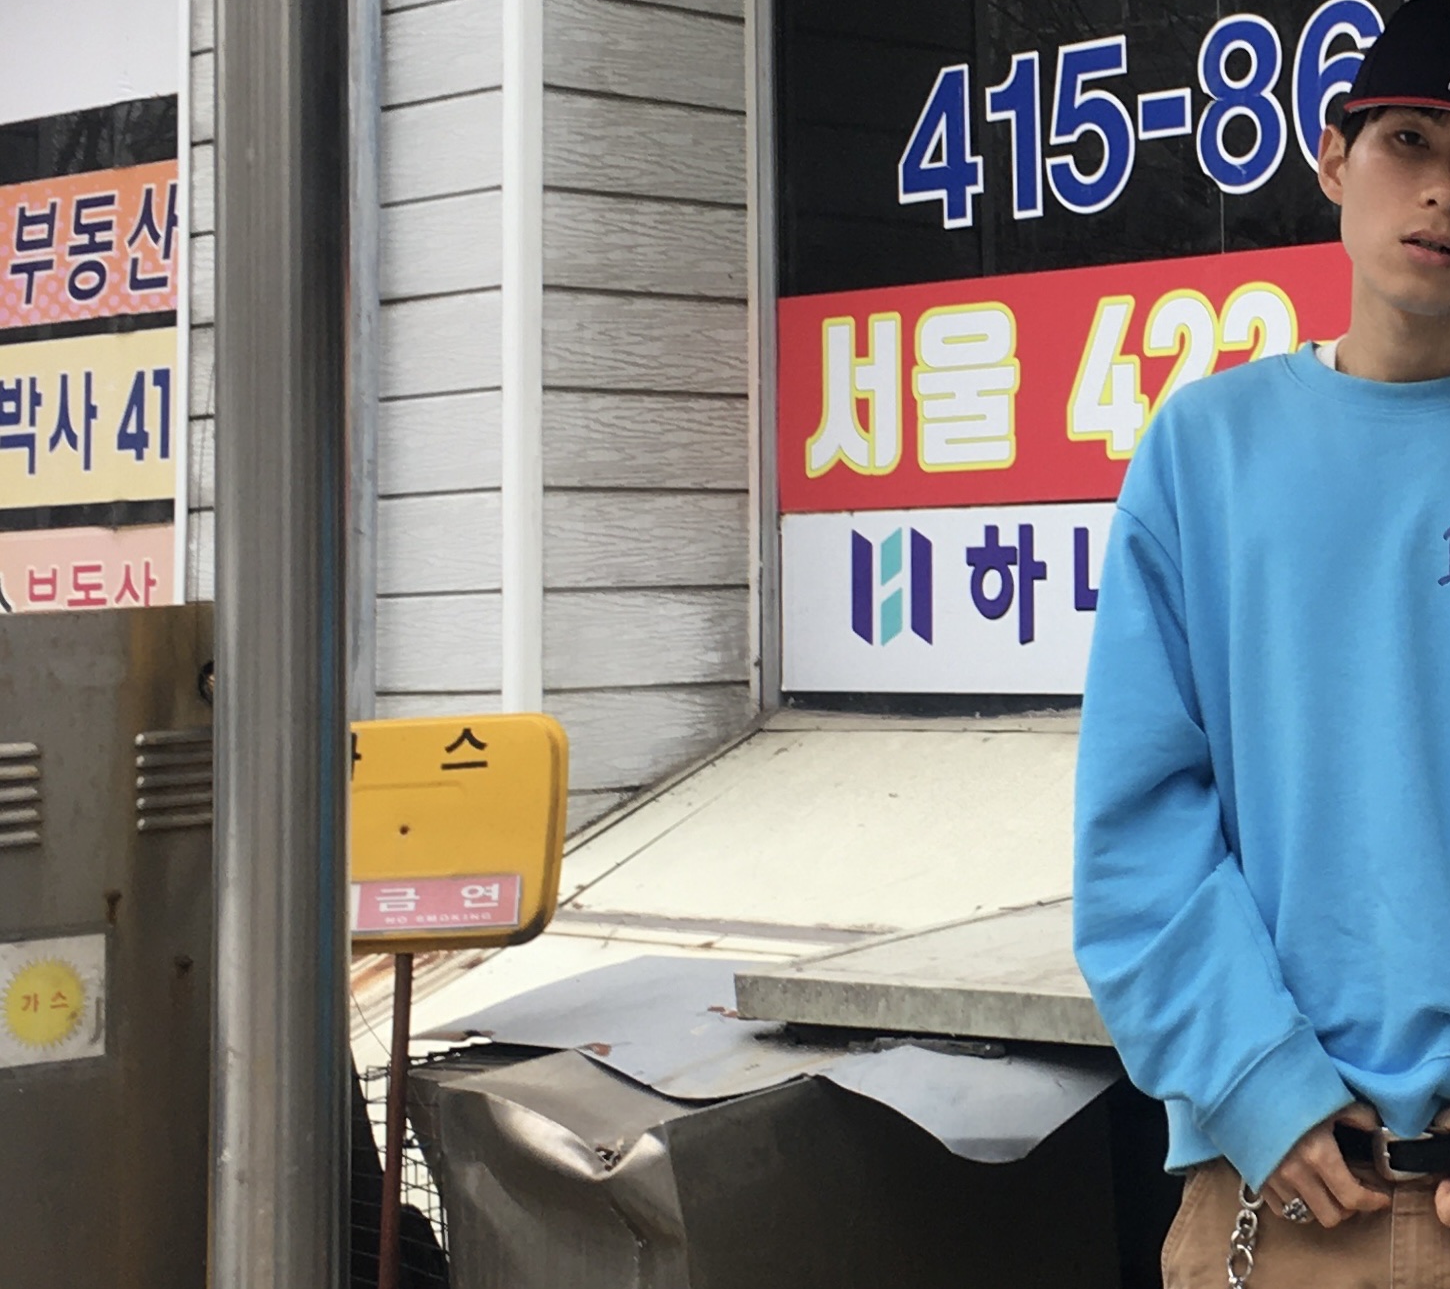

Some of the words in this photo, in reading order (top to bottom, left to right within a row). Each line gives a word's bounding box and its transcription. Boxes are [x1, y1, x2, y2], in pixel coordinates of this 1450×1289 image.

[10, 183, 178, 306] 부동산
[0, 371, 98, 475] 박사
[117, 368, 171, 462] 41
[805, 301, 1020, 479] 서울
[375, 882, 500, 913] 금연
[21, 990, 70, 1013] 가스
